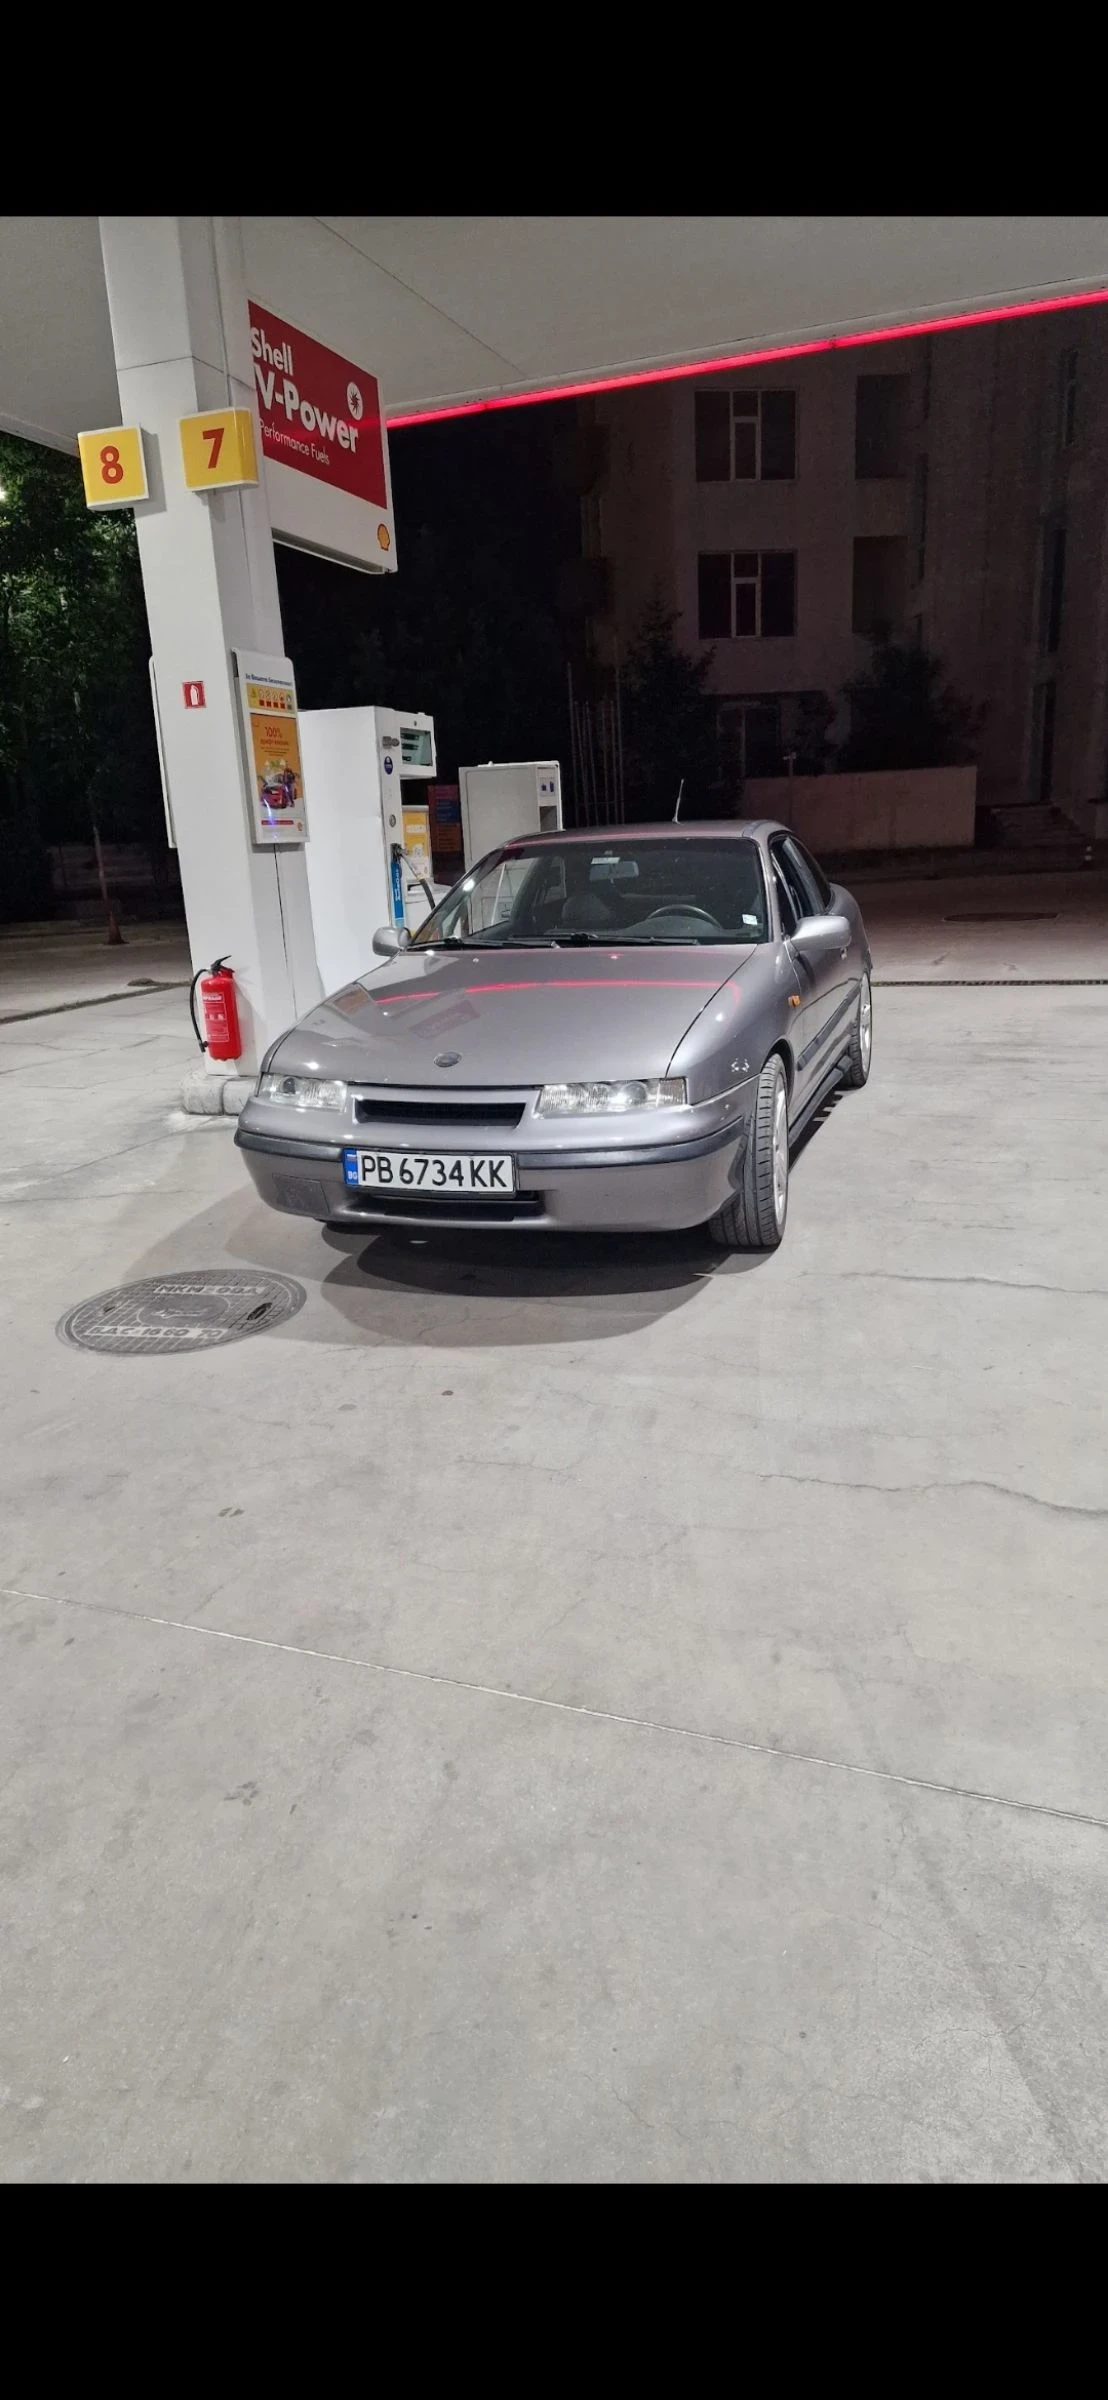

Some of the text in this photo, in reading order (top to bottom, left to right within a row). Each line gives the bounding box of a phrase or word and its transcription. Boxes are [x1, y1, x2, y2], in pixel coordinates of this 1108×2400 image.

[250, 326, 294, 376] Shell
[254, 361, 359, 453] V-Power
[100, 445, 124, 484] 8
[202, 427, 225, 469] 7
[260, 418, 330, 466] Performance Fuels
[399, 1158, 464, 1187] 6734
[470, 1159, 508, 1188] KK
